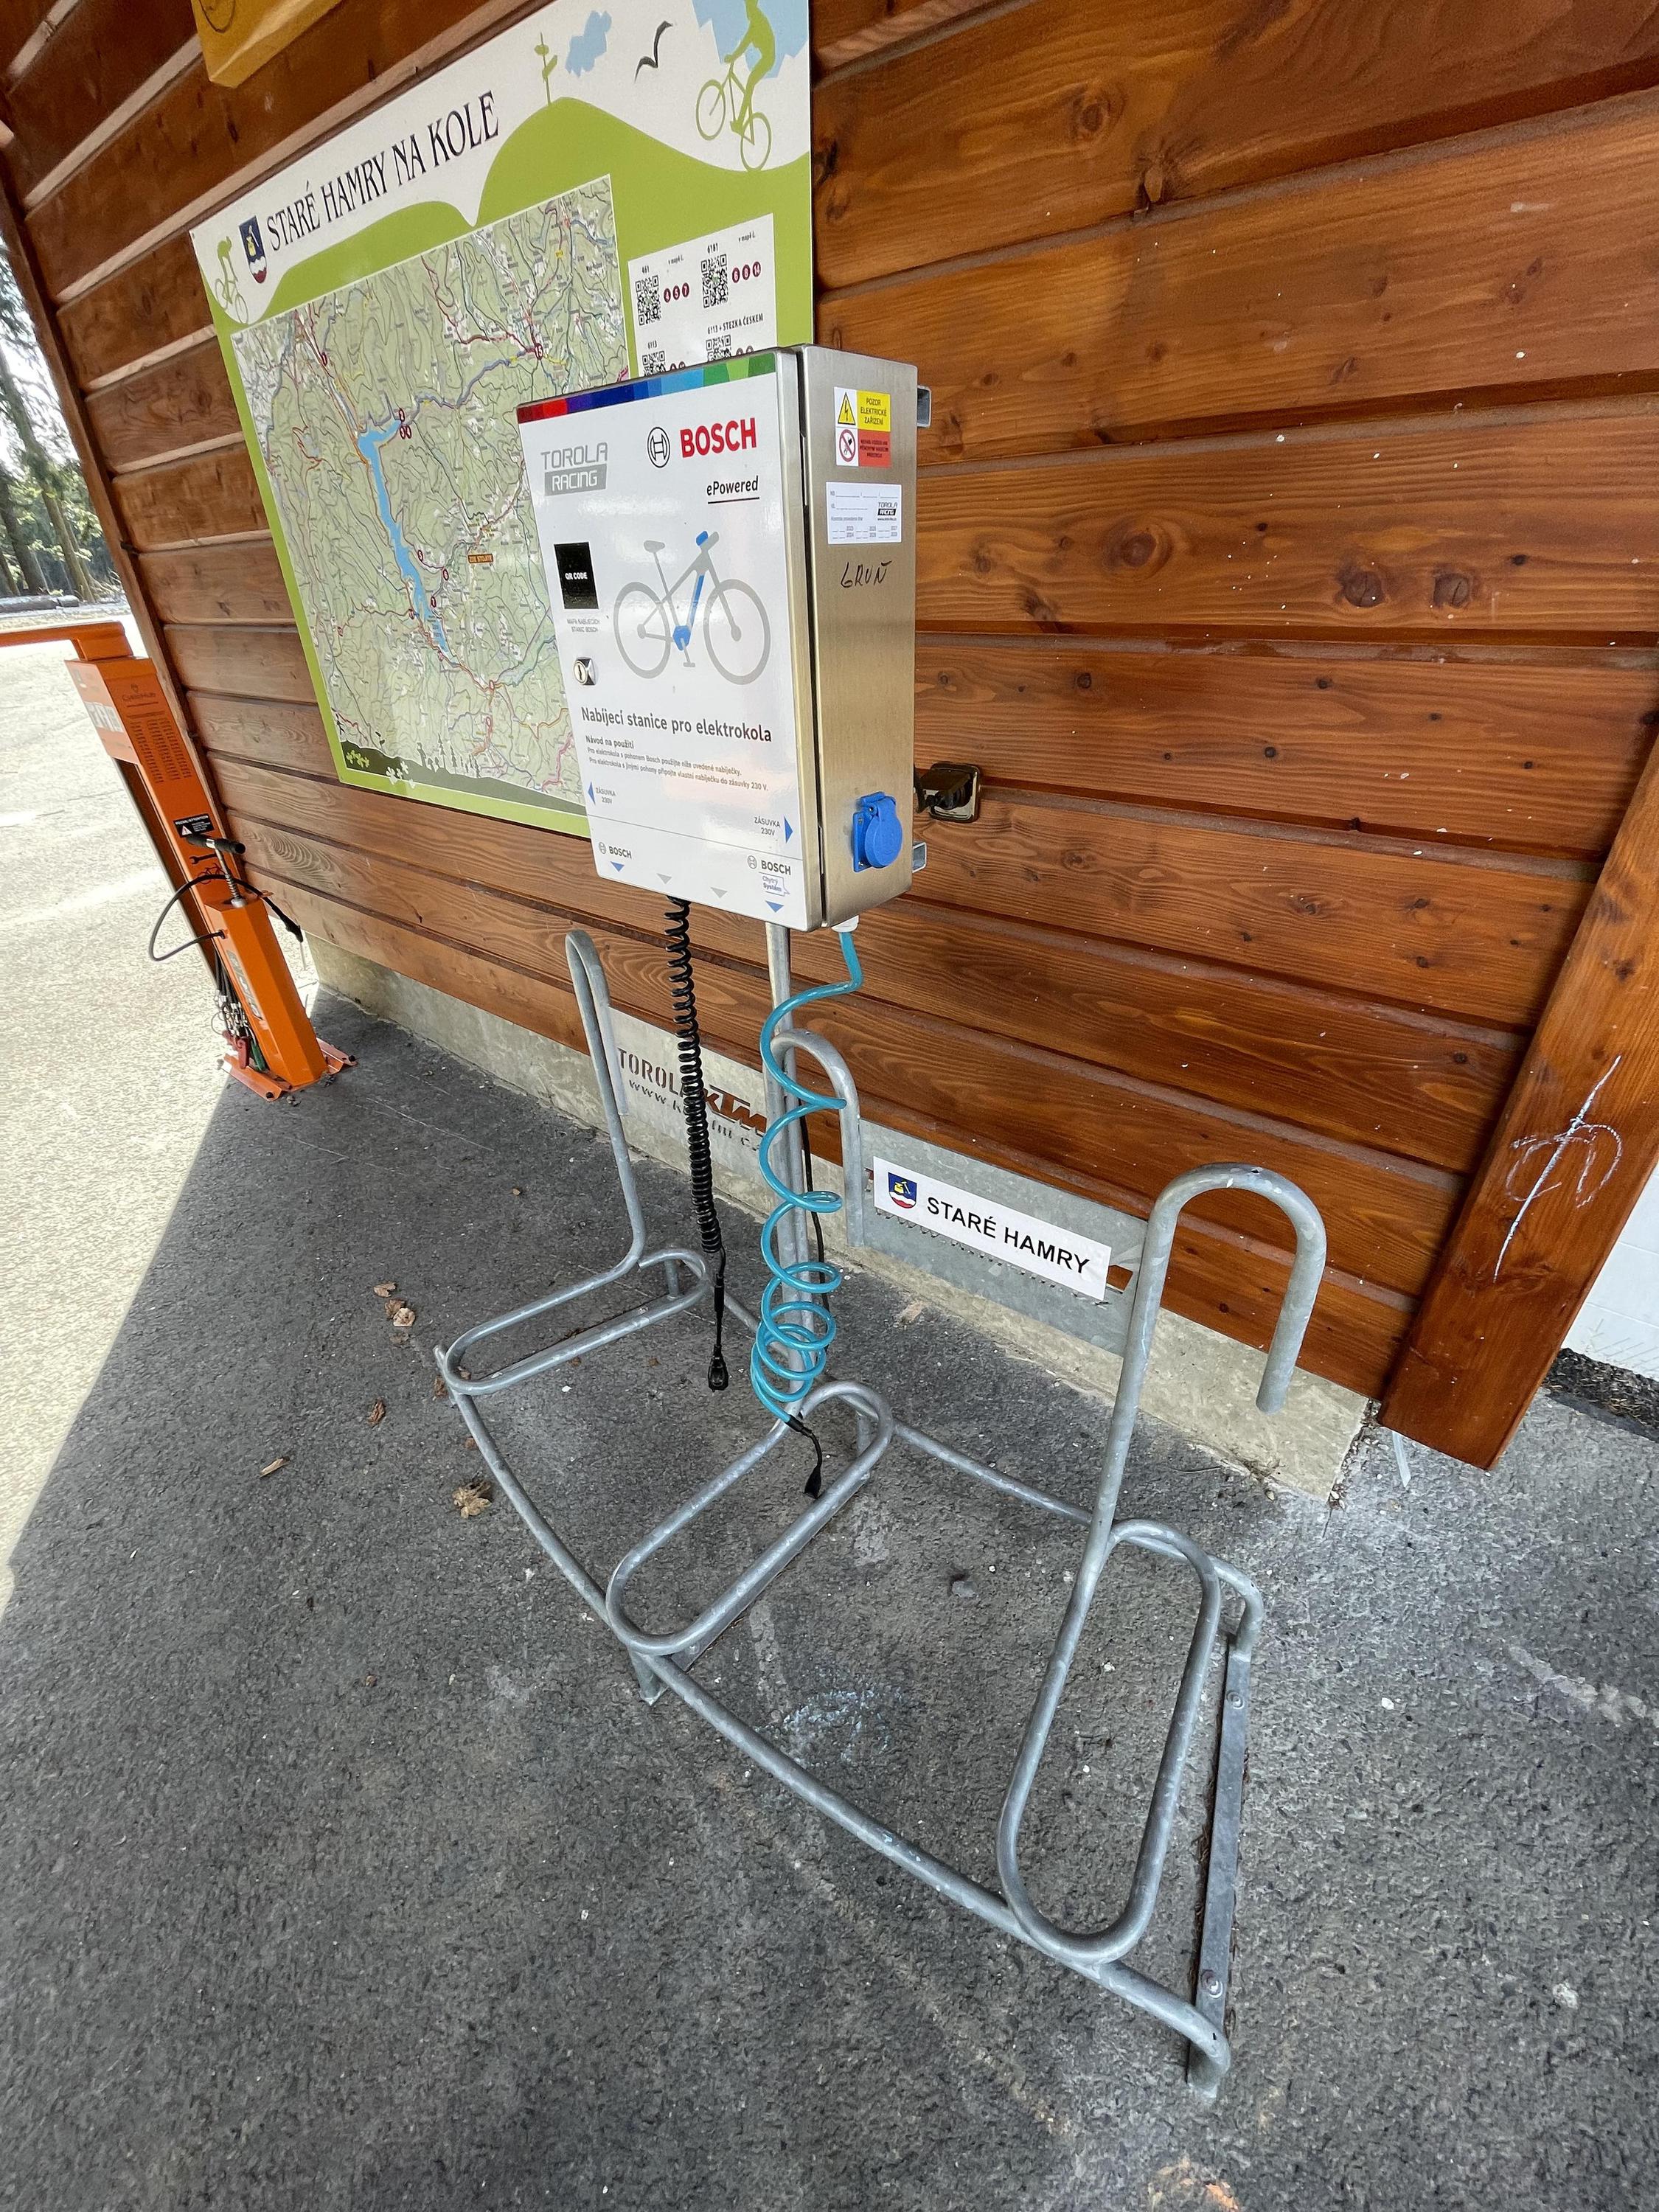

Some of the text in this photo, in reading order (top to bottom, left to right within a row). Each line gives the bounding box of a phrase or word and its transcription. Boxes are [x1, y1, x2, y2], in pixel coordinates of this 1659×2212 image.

[267, 90, 498, 251] STARÉ HAMRY NA KOLE
[723, 318, 742, 332] STEZKA
[742, 313, 764, 326] ČESKEM
[866, 397, 881, 406] POZOR
[680, 417, 757, 458] BOSCH
[540, 442, 608, 470] TOROLA
[552, 470, 597, 491] RACING
[706, 476, 759, 495] ePowered
[581, 706, 772, 742] Nabíjecí stanice pro elektrokola
[585, 735, 604, 745] Návod
[646, 755, 660, 763] Bosch
[751, 782, 762, 790] 230
[754, 815, 781, 828] ZÁSUVKA
[761, 827, 775, 835] 230V
[608, 845, 632, 859] BOSCH
[761, 860, 791, 875] BOSCH
[927, 1197, 1090, 1274] STARÉ HAMRY
